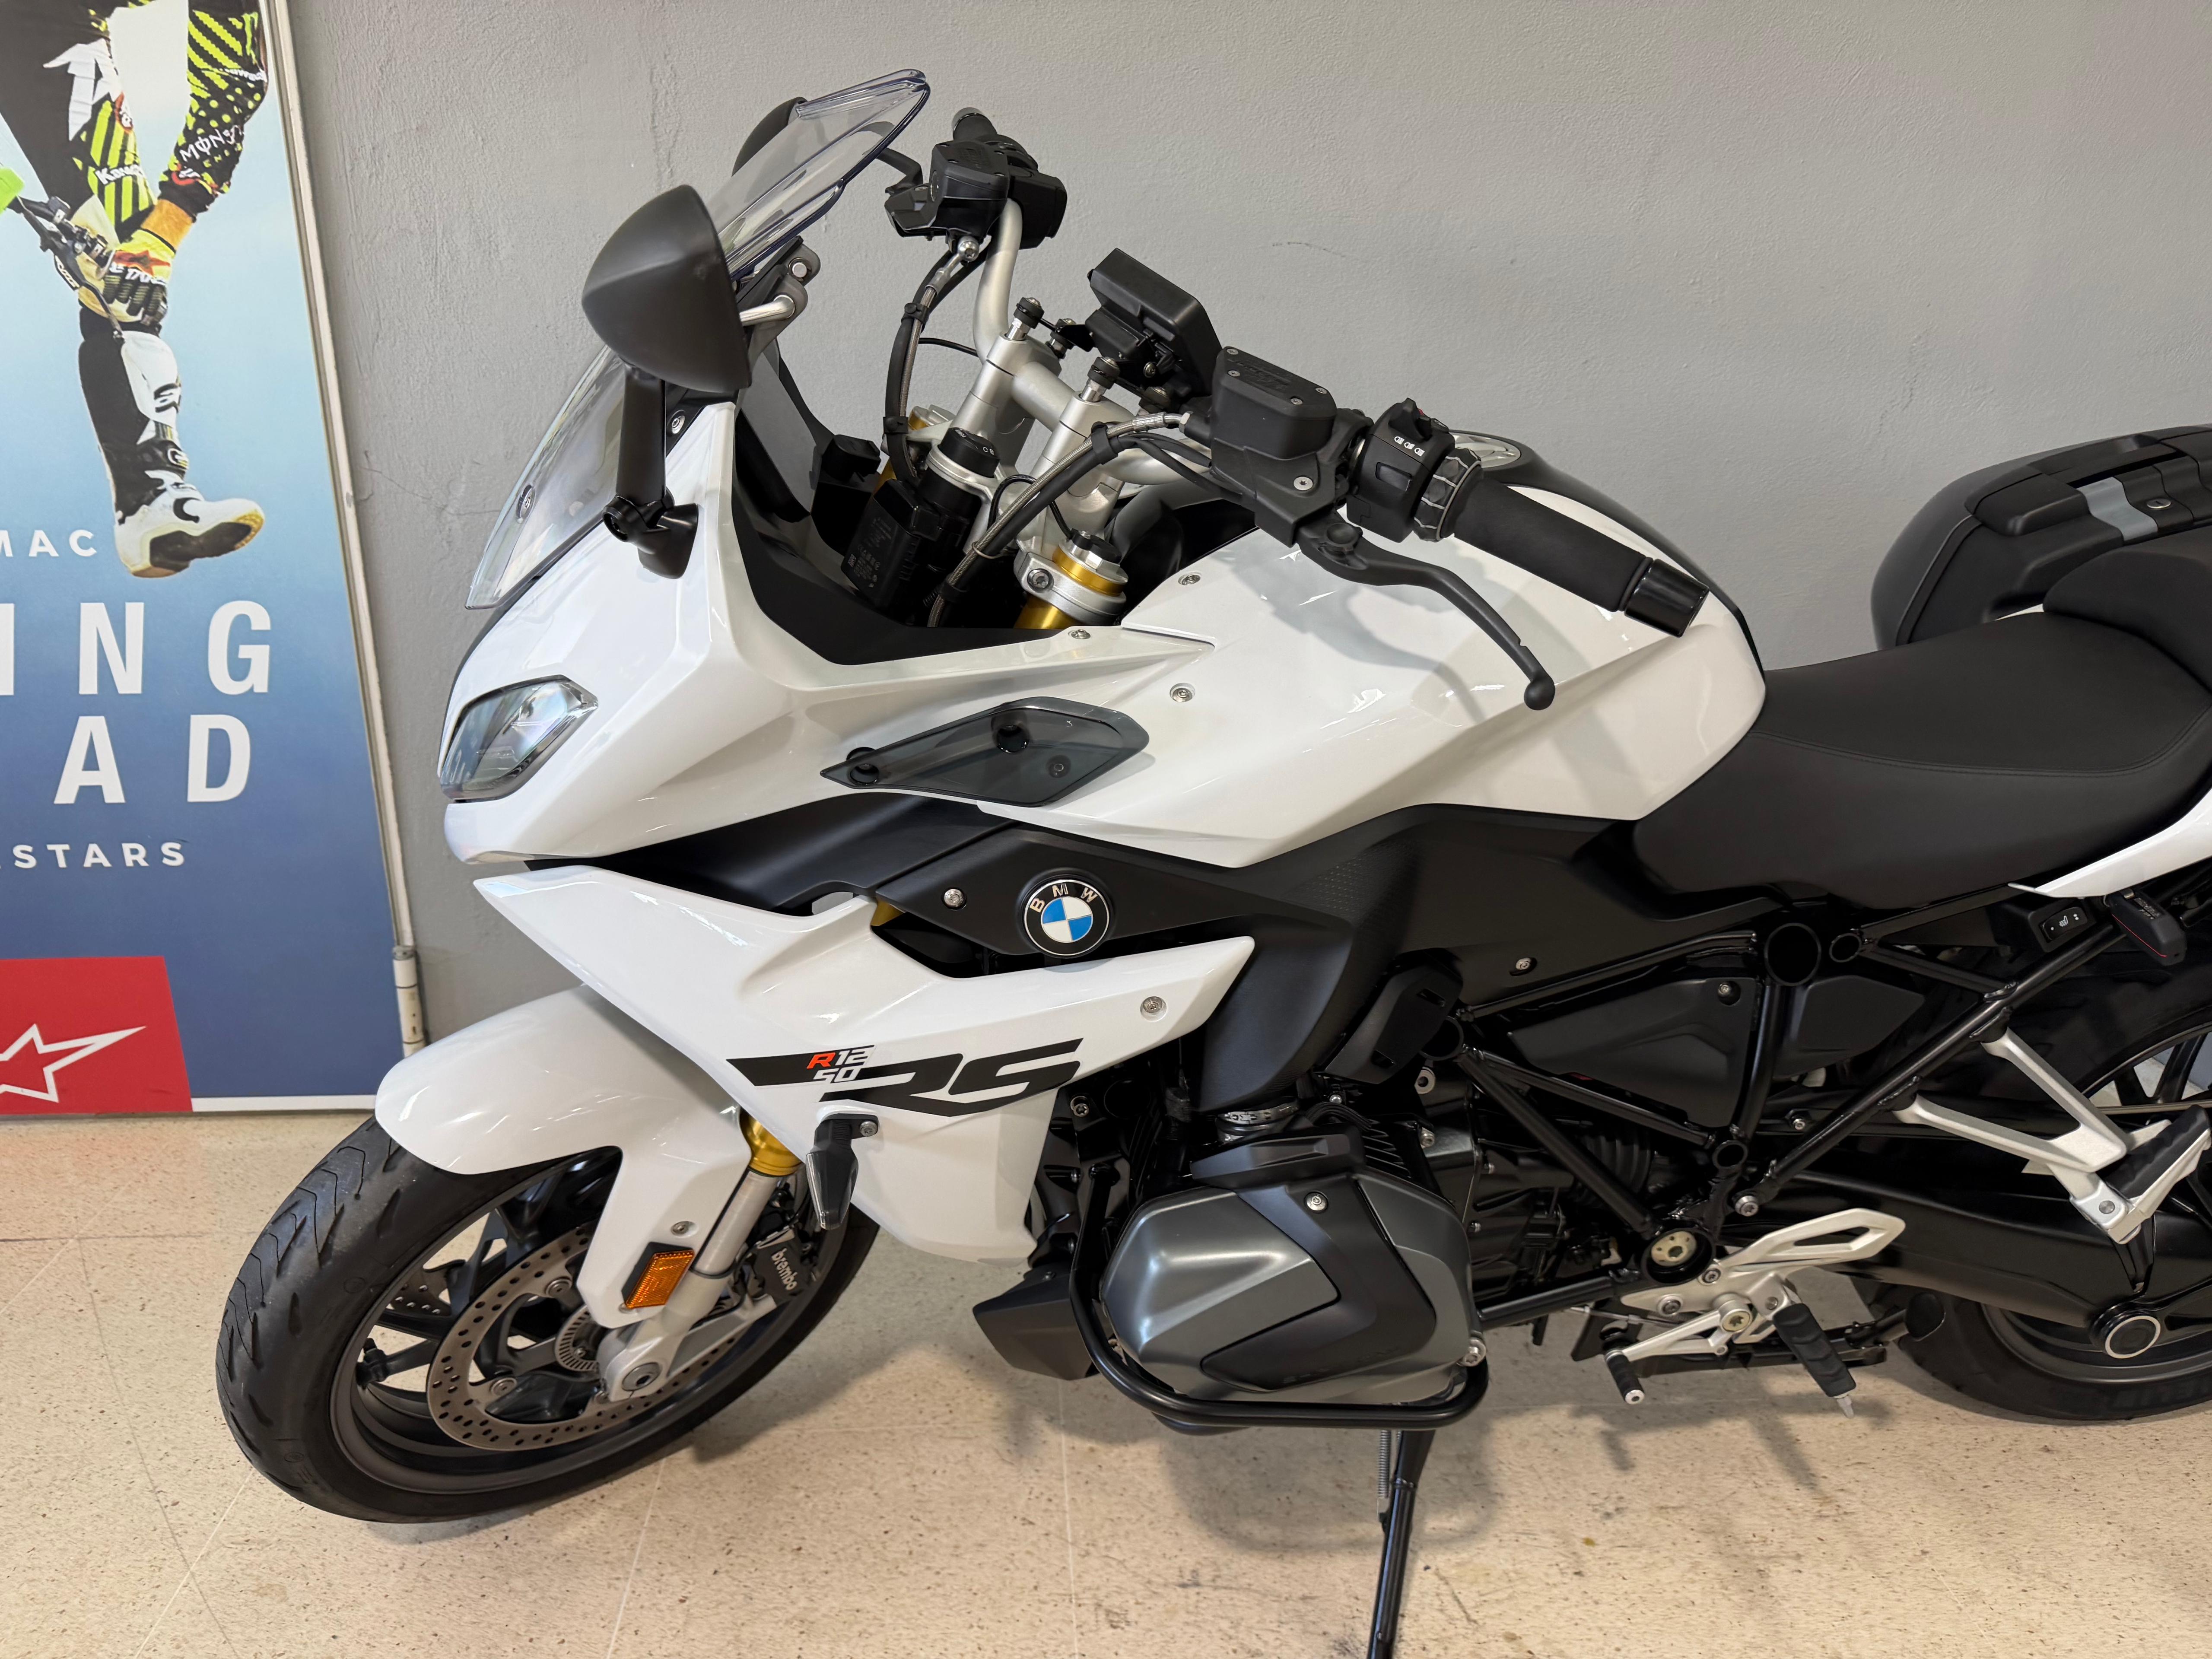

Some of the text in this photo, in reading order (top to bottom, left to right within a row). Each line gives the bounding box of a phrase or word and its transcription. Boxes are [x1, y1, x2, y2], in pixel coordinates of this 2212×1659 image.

[54, 714, 251, 804] AD
[0, 842, 184, 869] STARS
[1029, 883, 1098, 913] BMW
[820, 1038, 1083, 1117] RS
[771, 1248, 798, 1291] brembo
